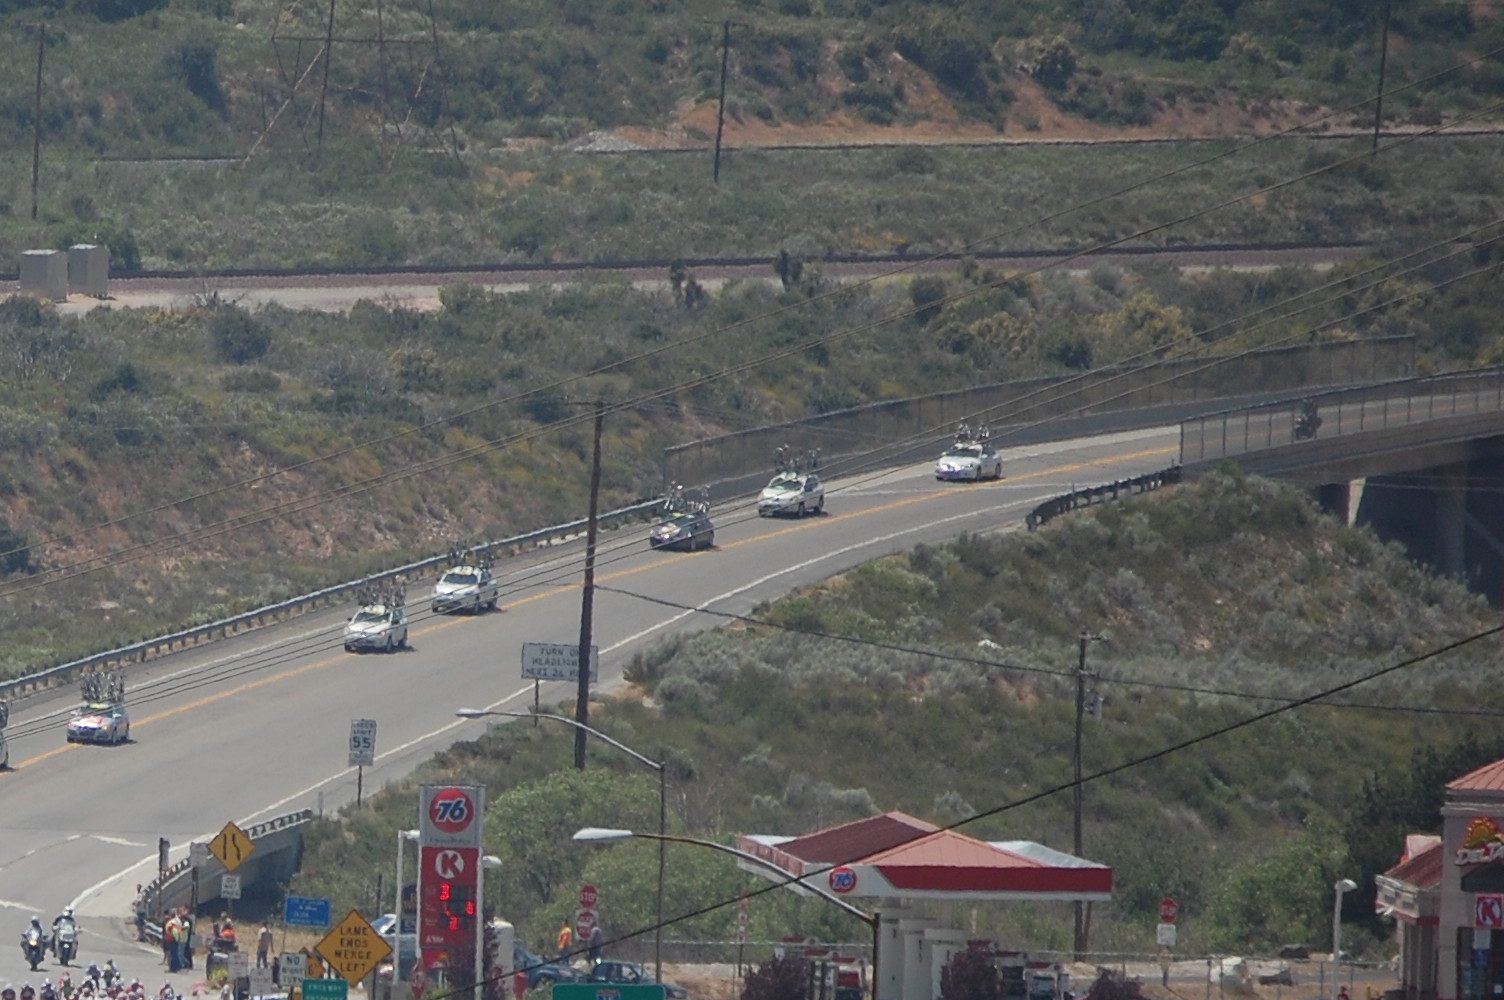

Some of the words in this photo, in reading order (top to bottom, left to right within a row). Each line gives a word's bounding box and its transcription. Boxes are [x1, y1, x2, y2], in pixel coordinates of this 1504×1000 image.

[540, 647, 564, 656] TURN
[353, 736, 371, 748] 55
[436, 798, 467, 823] 76
[832, 871, 854, 889] 76
[340, 927, 368, 936] LANE
[340, 938, 368, 948] ENDS
[335, 951, 372, 960] MERGE
[286, 956, 300, 965] NO
[340, 963, 366, 972] LEFT
